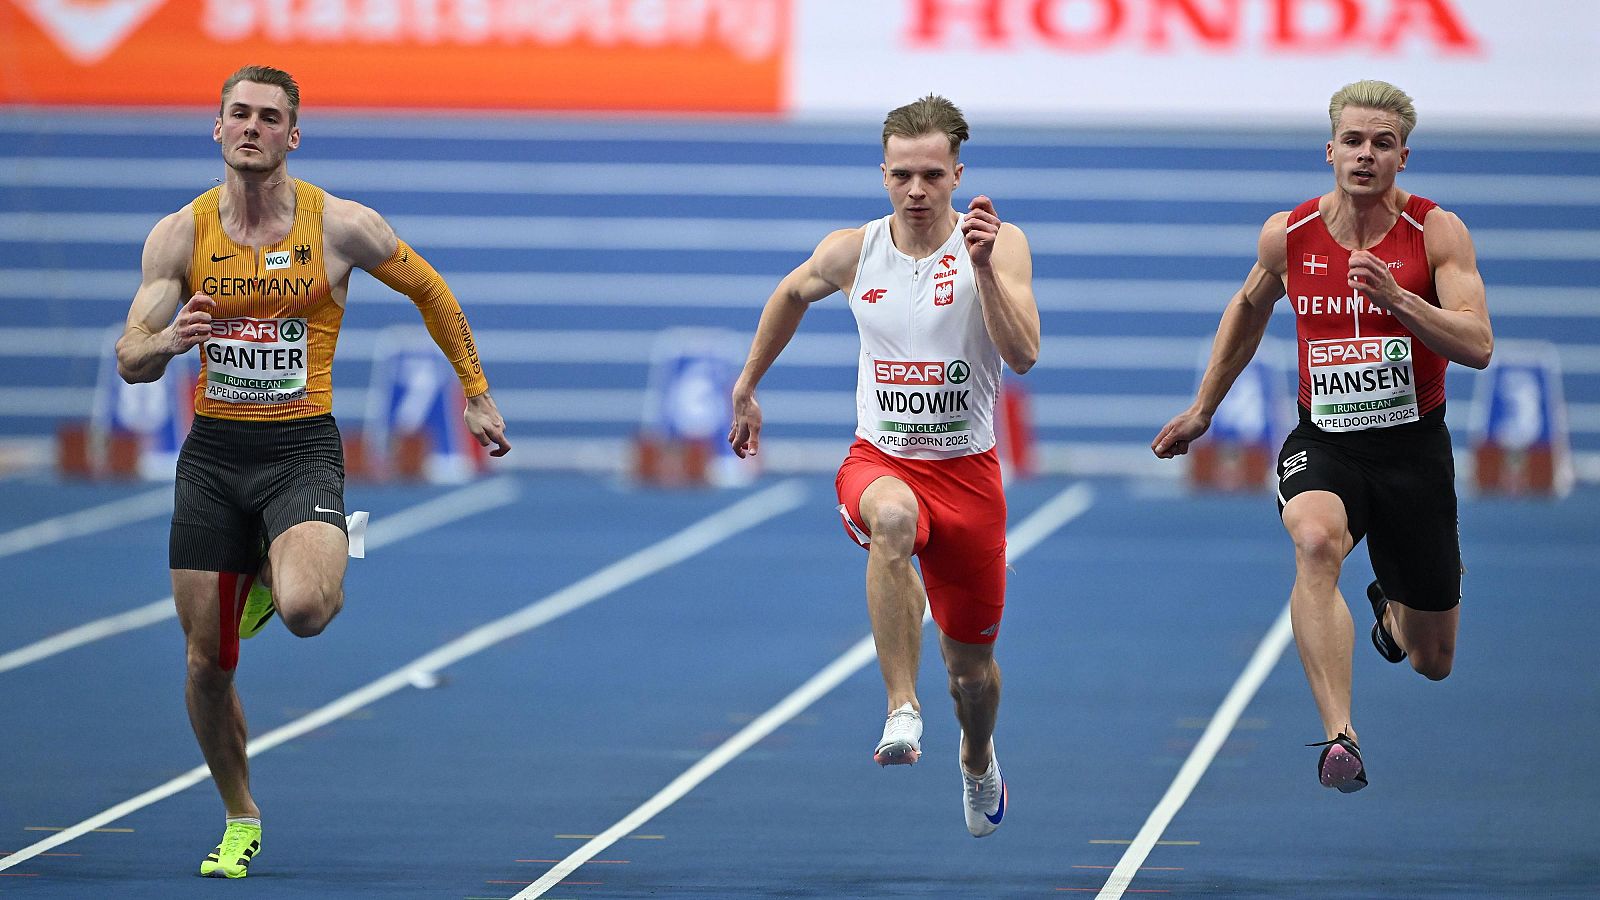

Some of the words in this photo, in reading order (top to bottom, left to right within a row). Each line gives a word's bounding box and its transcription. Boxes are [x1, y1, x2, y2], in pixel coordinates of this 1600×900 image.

[265, 255, 290, 266] WGV
[934, 268, 958, 280] ORLEN
[202, 276, 314, 297] GERMANY
[861, 288, 888, 304] 4F
[1297, 295, 1392, 316] DENMA
[211, 320, 276, 339] SPAR
[455, 311, 481, 374] GERMANY
[206, 342, 304, 371] GANTER
[1311, 342, 1380, 364] SPAR
[228, 376, 247, 387] RUN
[876, 363, 943, 382] SPAR
[1312, 365, 1410, 396] HANSEN
[209, 386, 275, 402] APELDOORN
[875, 389, 970, 415] WDOWIK
[1337, 402, 1357, 413] RUN
[1317, 413, 1387, 428] APELDOORN
[1388, 407, 1416, 422] 2025
[898, 423, 915, 432] RUN
[878, 435, 943, 447] APELDOORN
[945, 434, 969, 447] 2025
